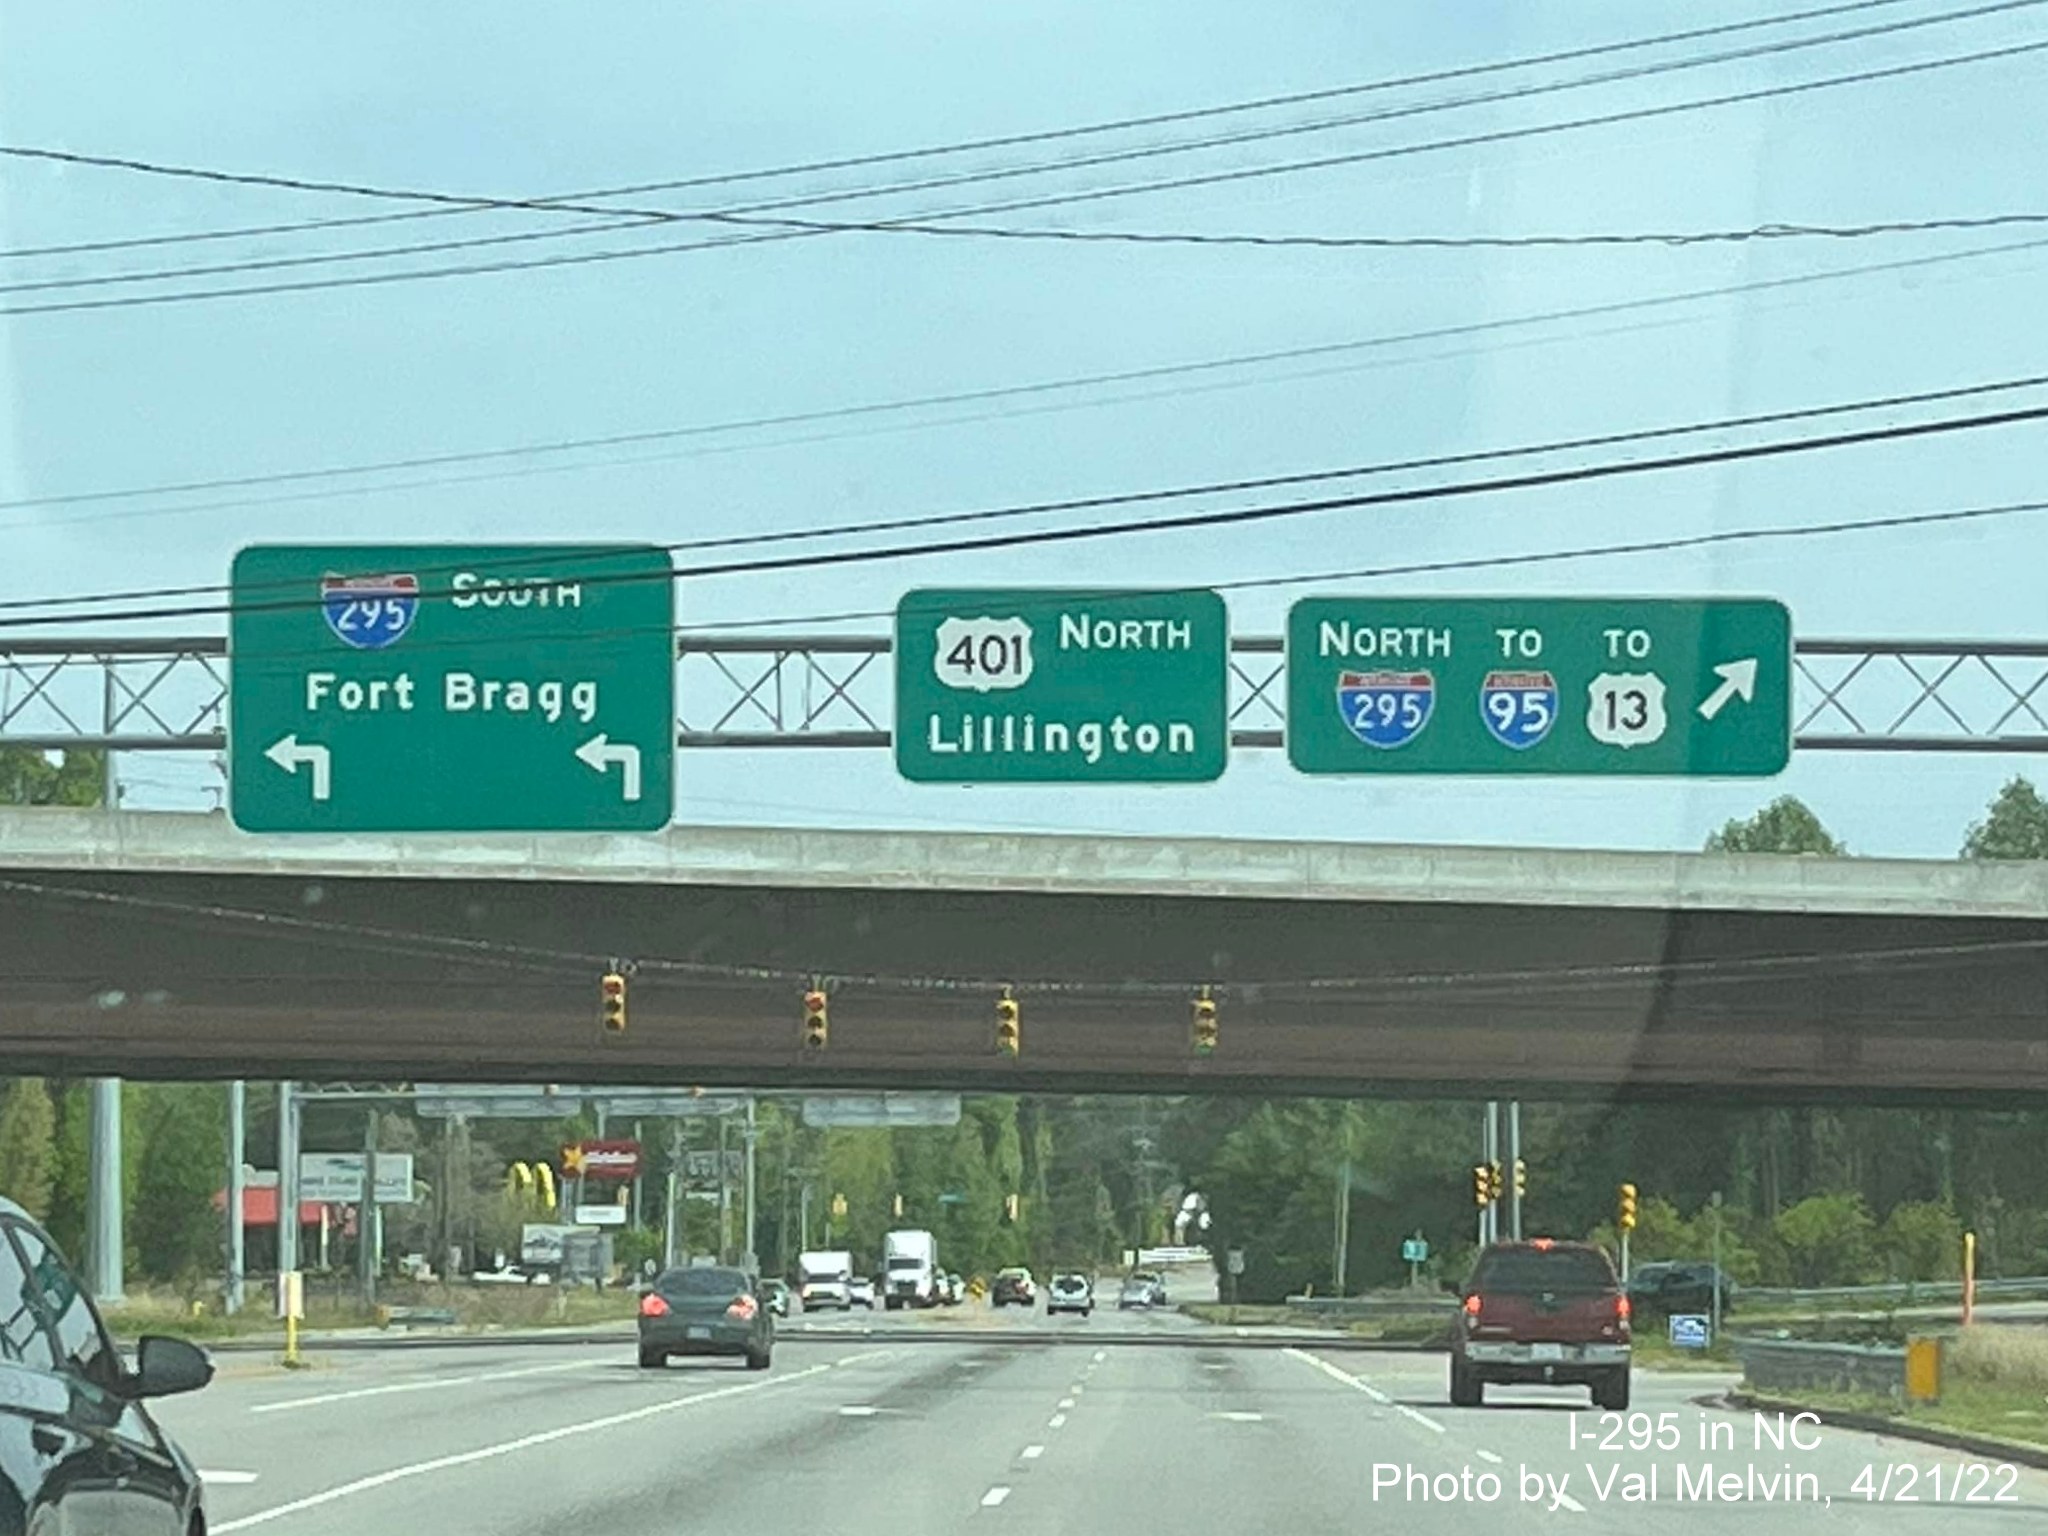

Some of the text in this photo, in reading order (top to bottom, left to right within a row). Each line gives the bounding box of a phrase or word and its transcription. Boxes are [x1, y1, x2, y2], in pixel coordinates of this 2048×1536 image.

[338, 596, 405, 631] 295
[946, 614, 1191, 675] 401 NORTH
[1319, 620, 1452, 658] NORTH
[1496, 628, 1543, 658] TO
[1603, 629, 1652, 658] TO
[306, 672, 598, 722] Fort Bragg
[1354, 692, 1423, 730] 295
[1487, 691, 1550, 733] 95
[1605, 690, 1648, 731] 13
[929, 714, 1194, 765] Lillington
